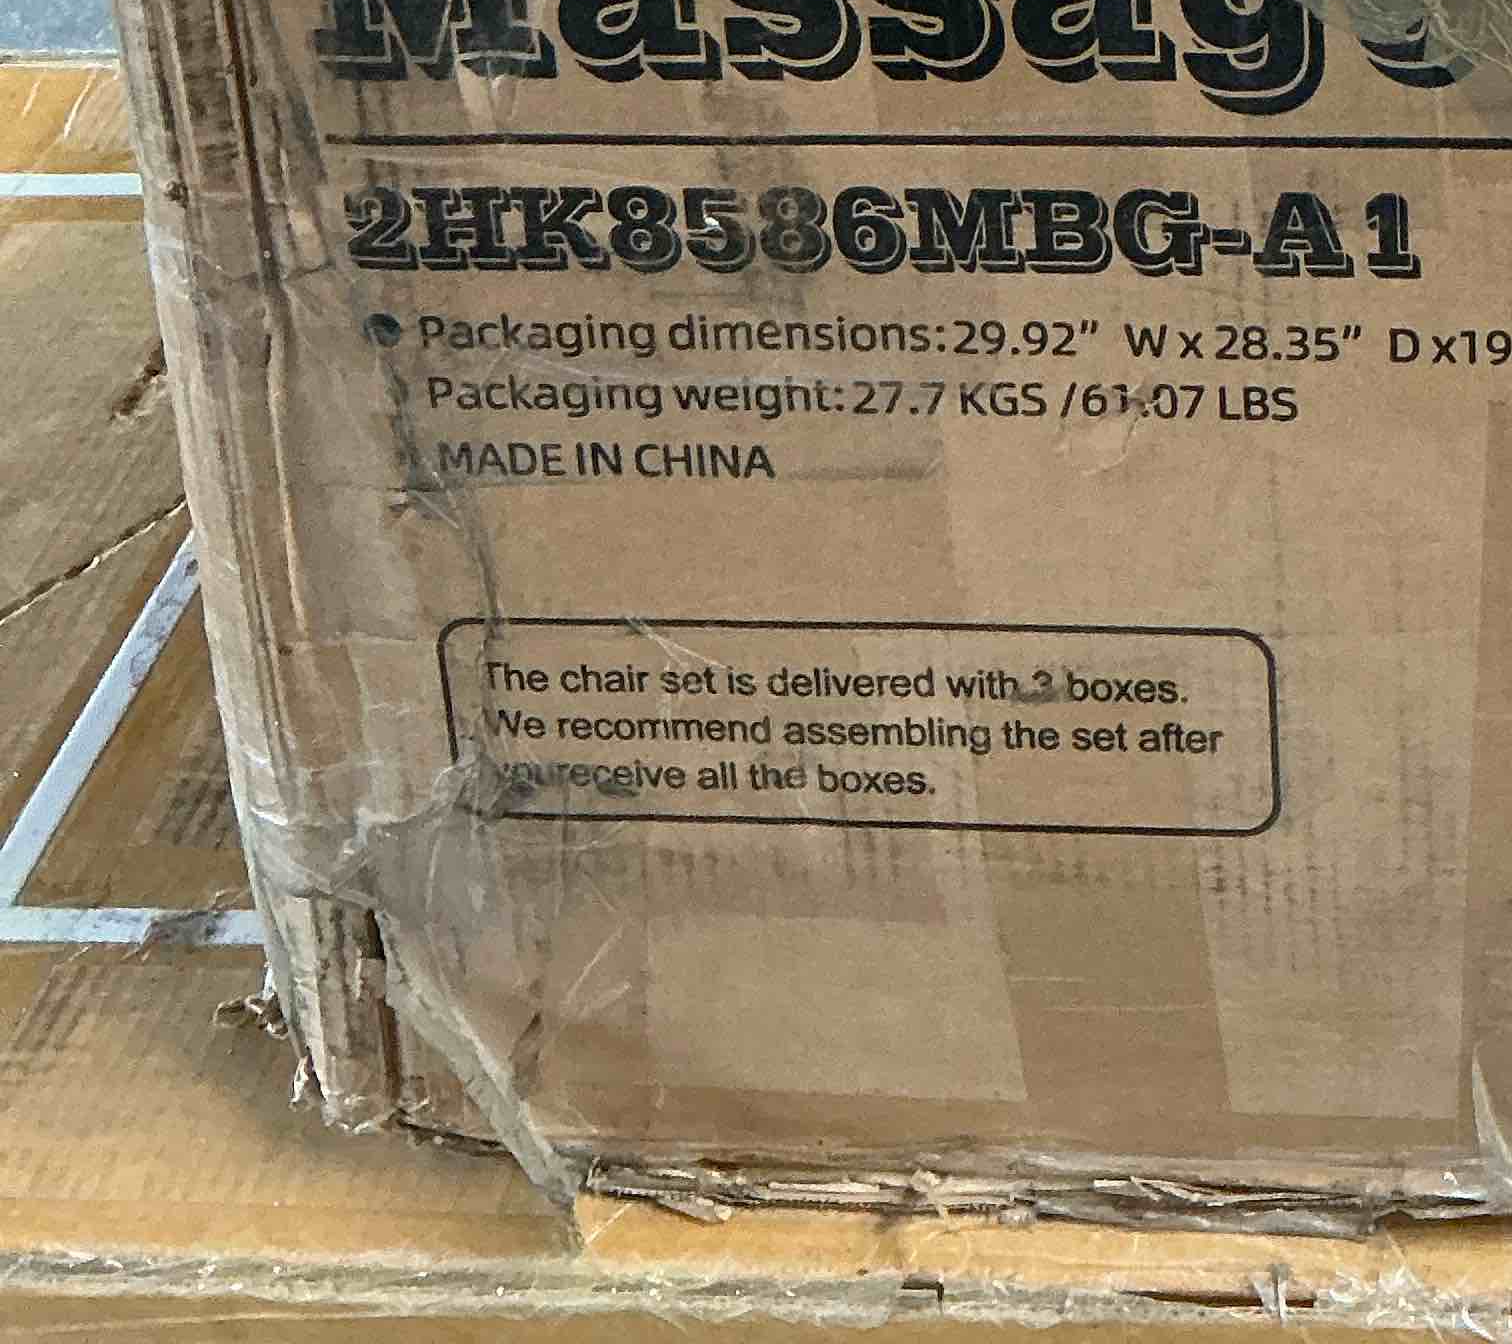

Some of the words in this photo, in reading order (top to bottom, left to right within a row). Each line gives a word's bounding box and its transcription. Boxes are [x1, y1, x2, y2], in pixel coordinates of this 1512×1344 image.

[343, 184, 1422, 279] 2HK8586MBG-A1
[419, 313, 656, 358] Packaging
[426, 375, 662, 420] Packaging
[959, 381, 1048, 416] KGS
[1218, 385, 1299, 422] LBS
[436, 439, 563, 477] MADE
[576, 441, 623, 477] IN
[633, 443, 778, 479] CHINA
[485, 661, 549, 694] The
[559, 664, 649, 695] chair
[659, 666, 717, 696] set
[727, 664, 758, 697] is
[766, 665, 935, 699] delivered
[945, 668, 1018, 701] with
[1065, 670, 1189, 705] boxes.
[490, 708, 547, 740] We
[557, 713, 772, 745] recommend
[783, 716, 992, 756] assembling
[1000, 719, 1062, 752] the
[1071, 720, 1130, 753] set
[1137, 721, 1225, 755] after
[551, 758, 687, 790] receive
[696, 761, 738, 791] all
[749, 762, 808, 792] the
[816, 763, 937, 796] boxes.
